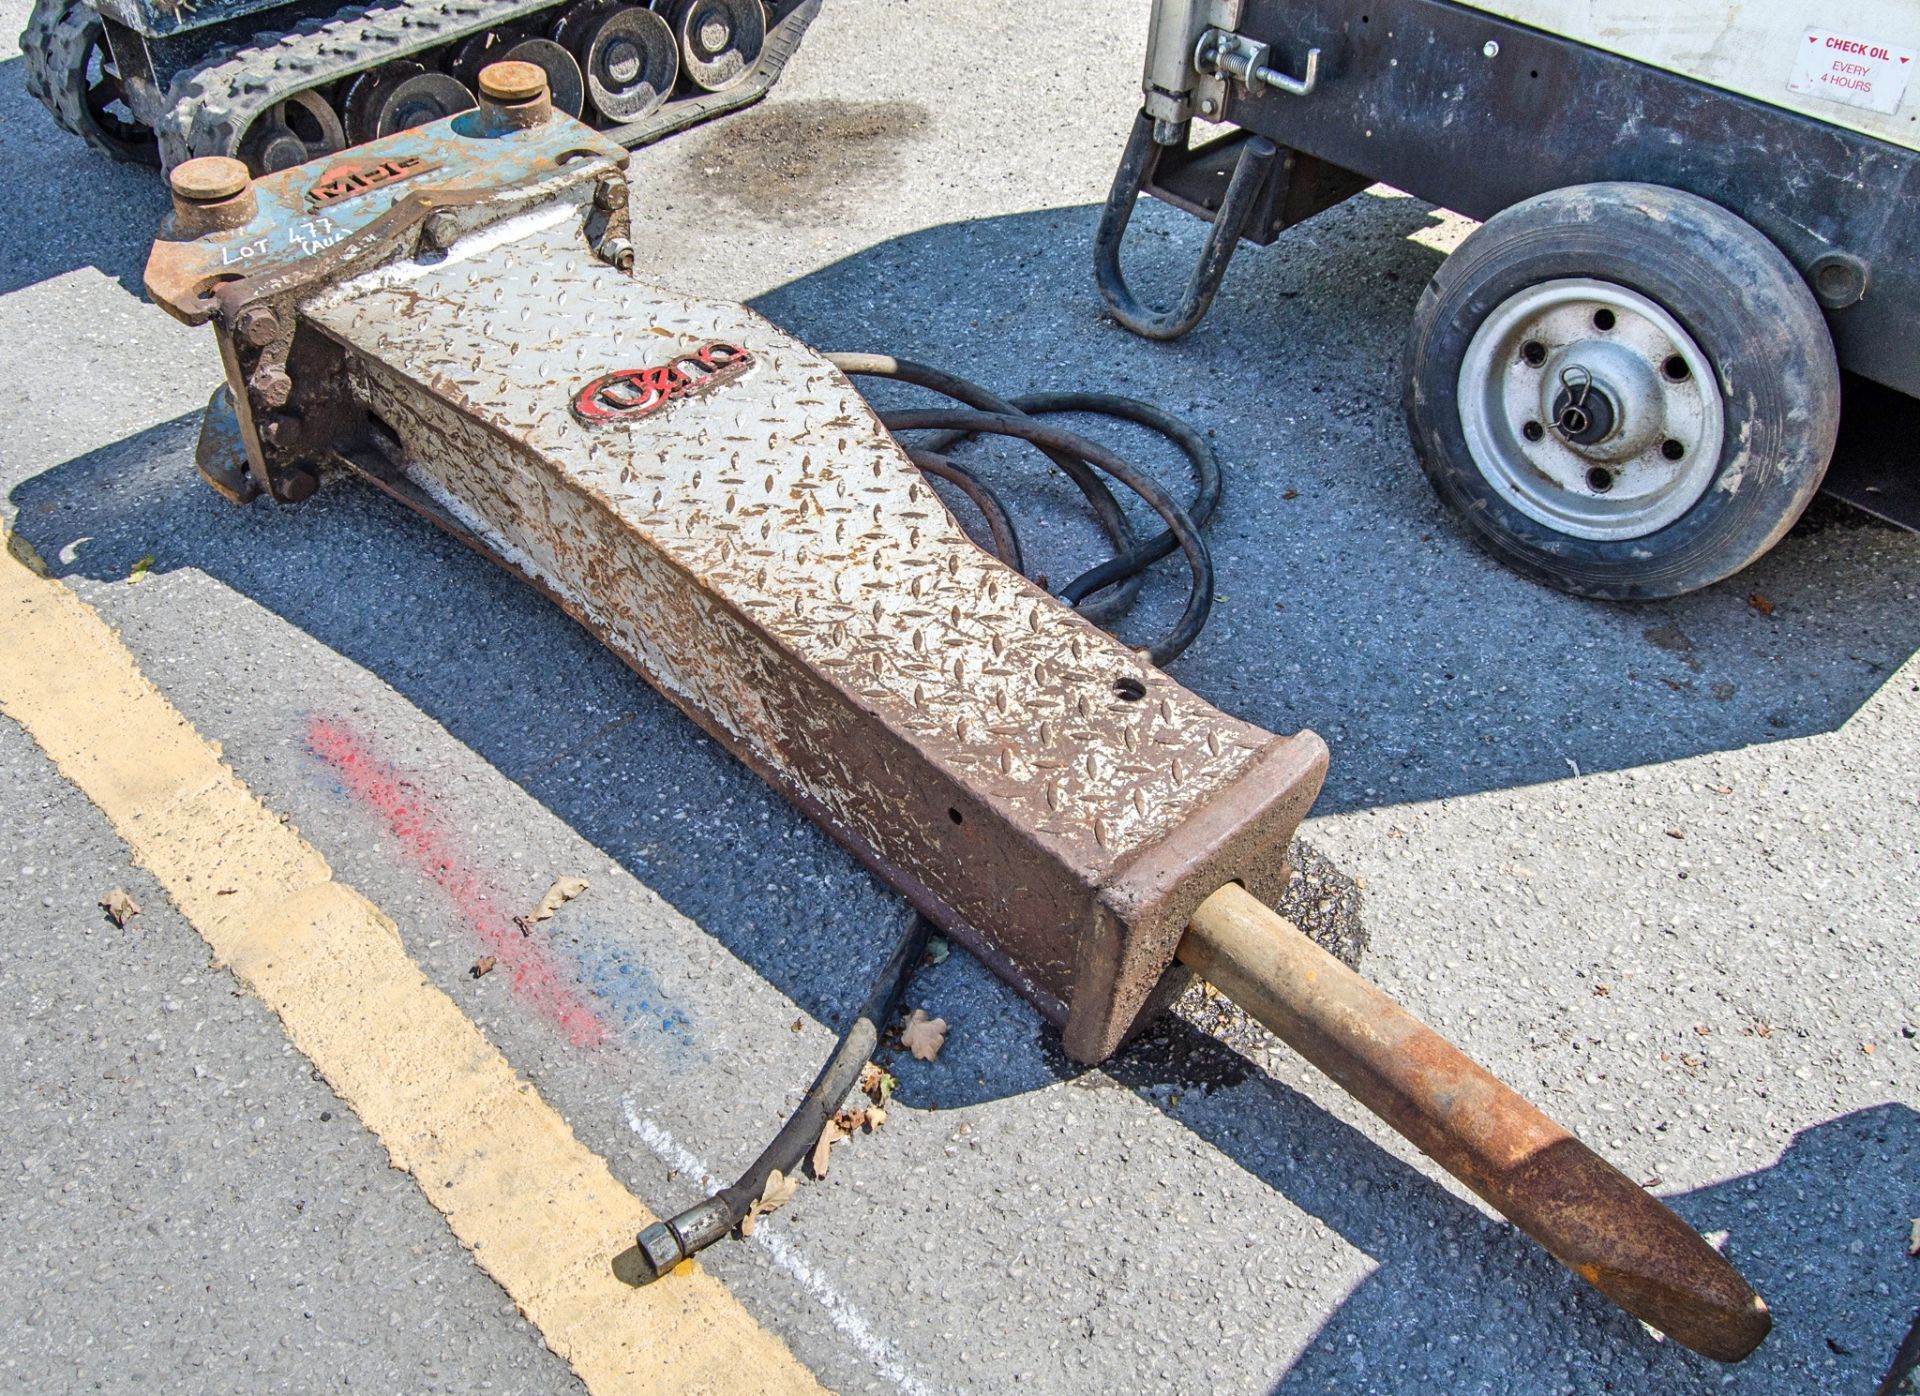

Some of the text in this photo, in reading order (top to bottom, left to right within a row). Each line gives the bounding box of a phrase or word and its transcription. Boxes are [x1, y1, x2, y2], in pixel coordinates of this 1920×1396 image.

[1825, 37, 1890, 61] CHECK OIL
[1832, 60, 1871, 77] EVERY
[1820, 73, 1872, 93] 4 HOURS
[221, 217, 333, 266] LOT 477
